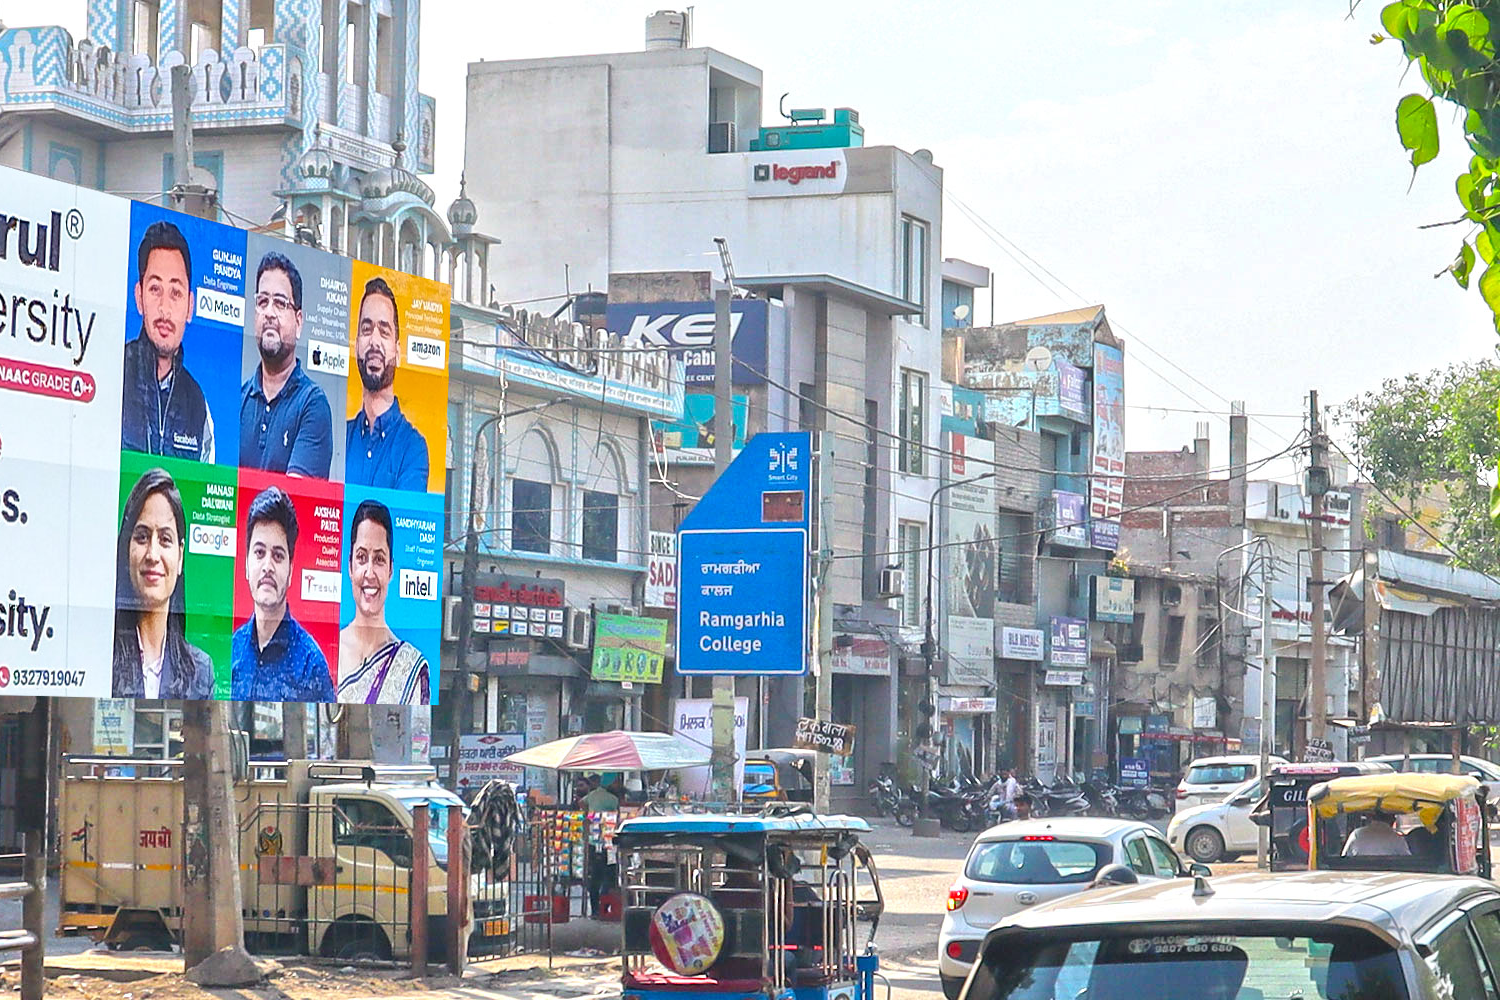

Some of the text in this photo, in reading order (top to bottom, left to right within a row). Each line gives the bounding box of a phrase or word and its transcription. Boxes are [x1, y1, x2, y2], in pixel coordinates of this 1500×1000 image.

[213, 248, 242, 267] GUNJAN
[214, 263, 242, 280] PANDYA
[214, 300, 241, 319] Meta
[410, 299, 444, 315] JAY VAIDYA
[411, 340, 441, 357] amazon
[322, 351, 345, 369] Apple
[683, 349, 716, 366] Cabl
[31, 372, 70, 392] GRADE
[206, 483, 235, 498] MANASI
[201, 497, 234, 511] DALWANI
[192, 511, 205, 520] Data
[314, 505, 340, 520] AKSHAR
[320, 519, 340, 532] PATEL
[395, 517, 436, 532] SANDHYARANI
[192, 526, 229, 550] Google
[313, 533, 340, 545] Production
[419, 532, 436, 544] DASH
[650, 534, 670, 554] SINCE
[321, 545, 339, 557] Quality
[315, 557, 339, 567] Associate
[700, 584, 734, 598] ਕਾਲਜ
[700, 611, 785, 631] Ramgarhia
[700, 635, 762, 654] College
[13, 668, 86, 687] 9327919047
[1283, 790, 1305, 802] GIL
